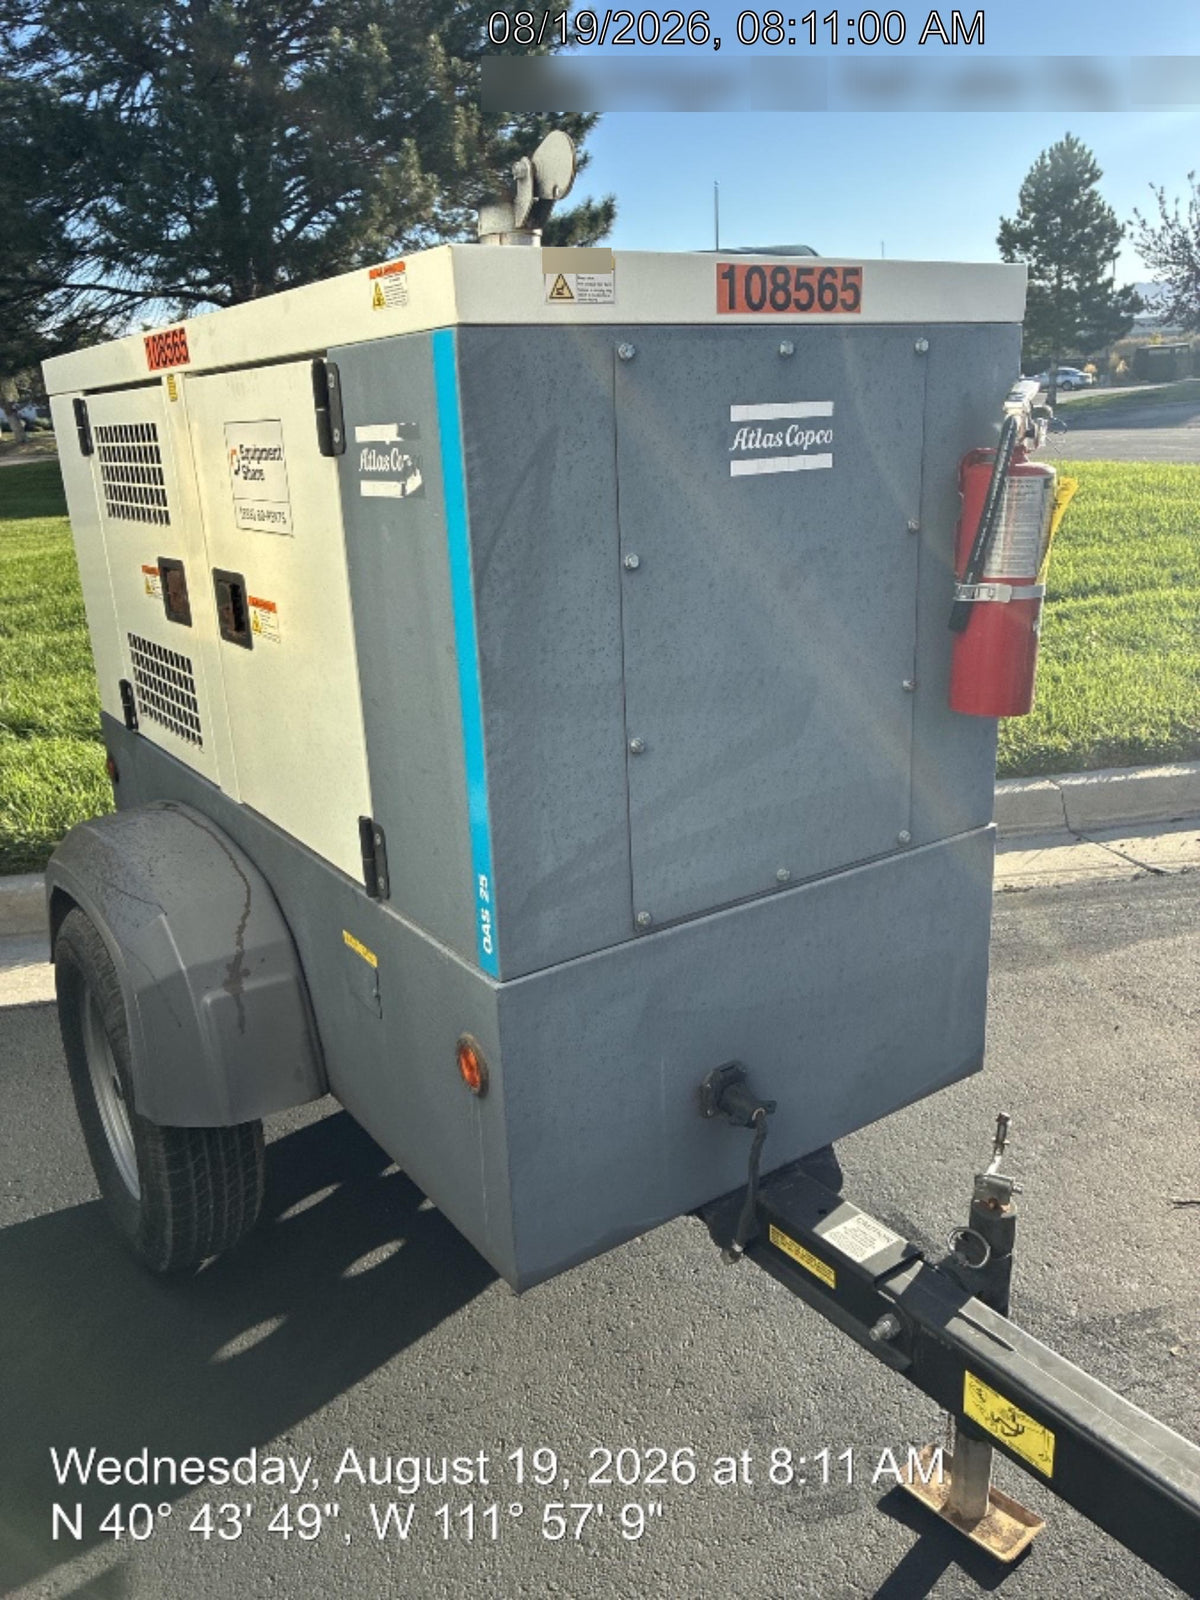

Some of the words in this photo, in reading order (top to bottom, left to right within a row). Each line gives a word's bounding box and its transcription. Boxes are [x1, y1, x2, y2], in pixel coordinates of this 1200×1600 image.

[721, 265, 861, 312] 108565
[729, 427, 783, 451] Atlas
[786, 424, 833, 450] Copco
[359, 448, 390, 472] Atlas
[479, 874, 490, 903] 25
[481, 907, 493, 955] QAS
